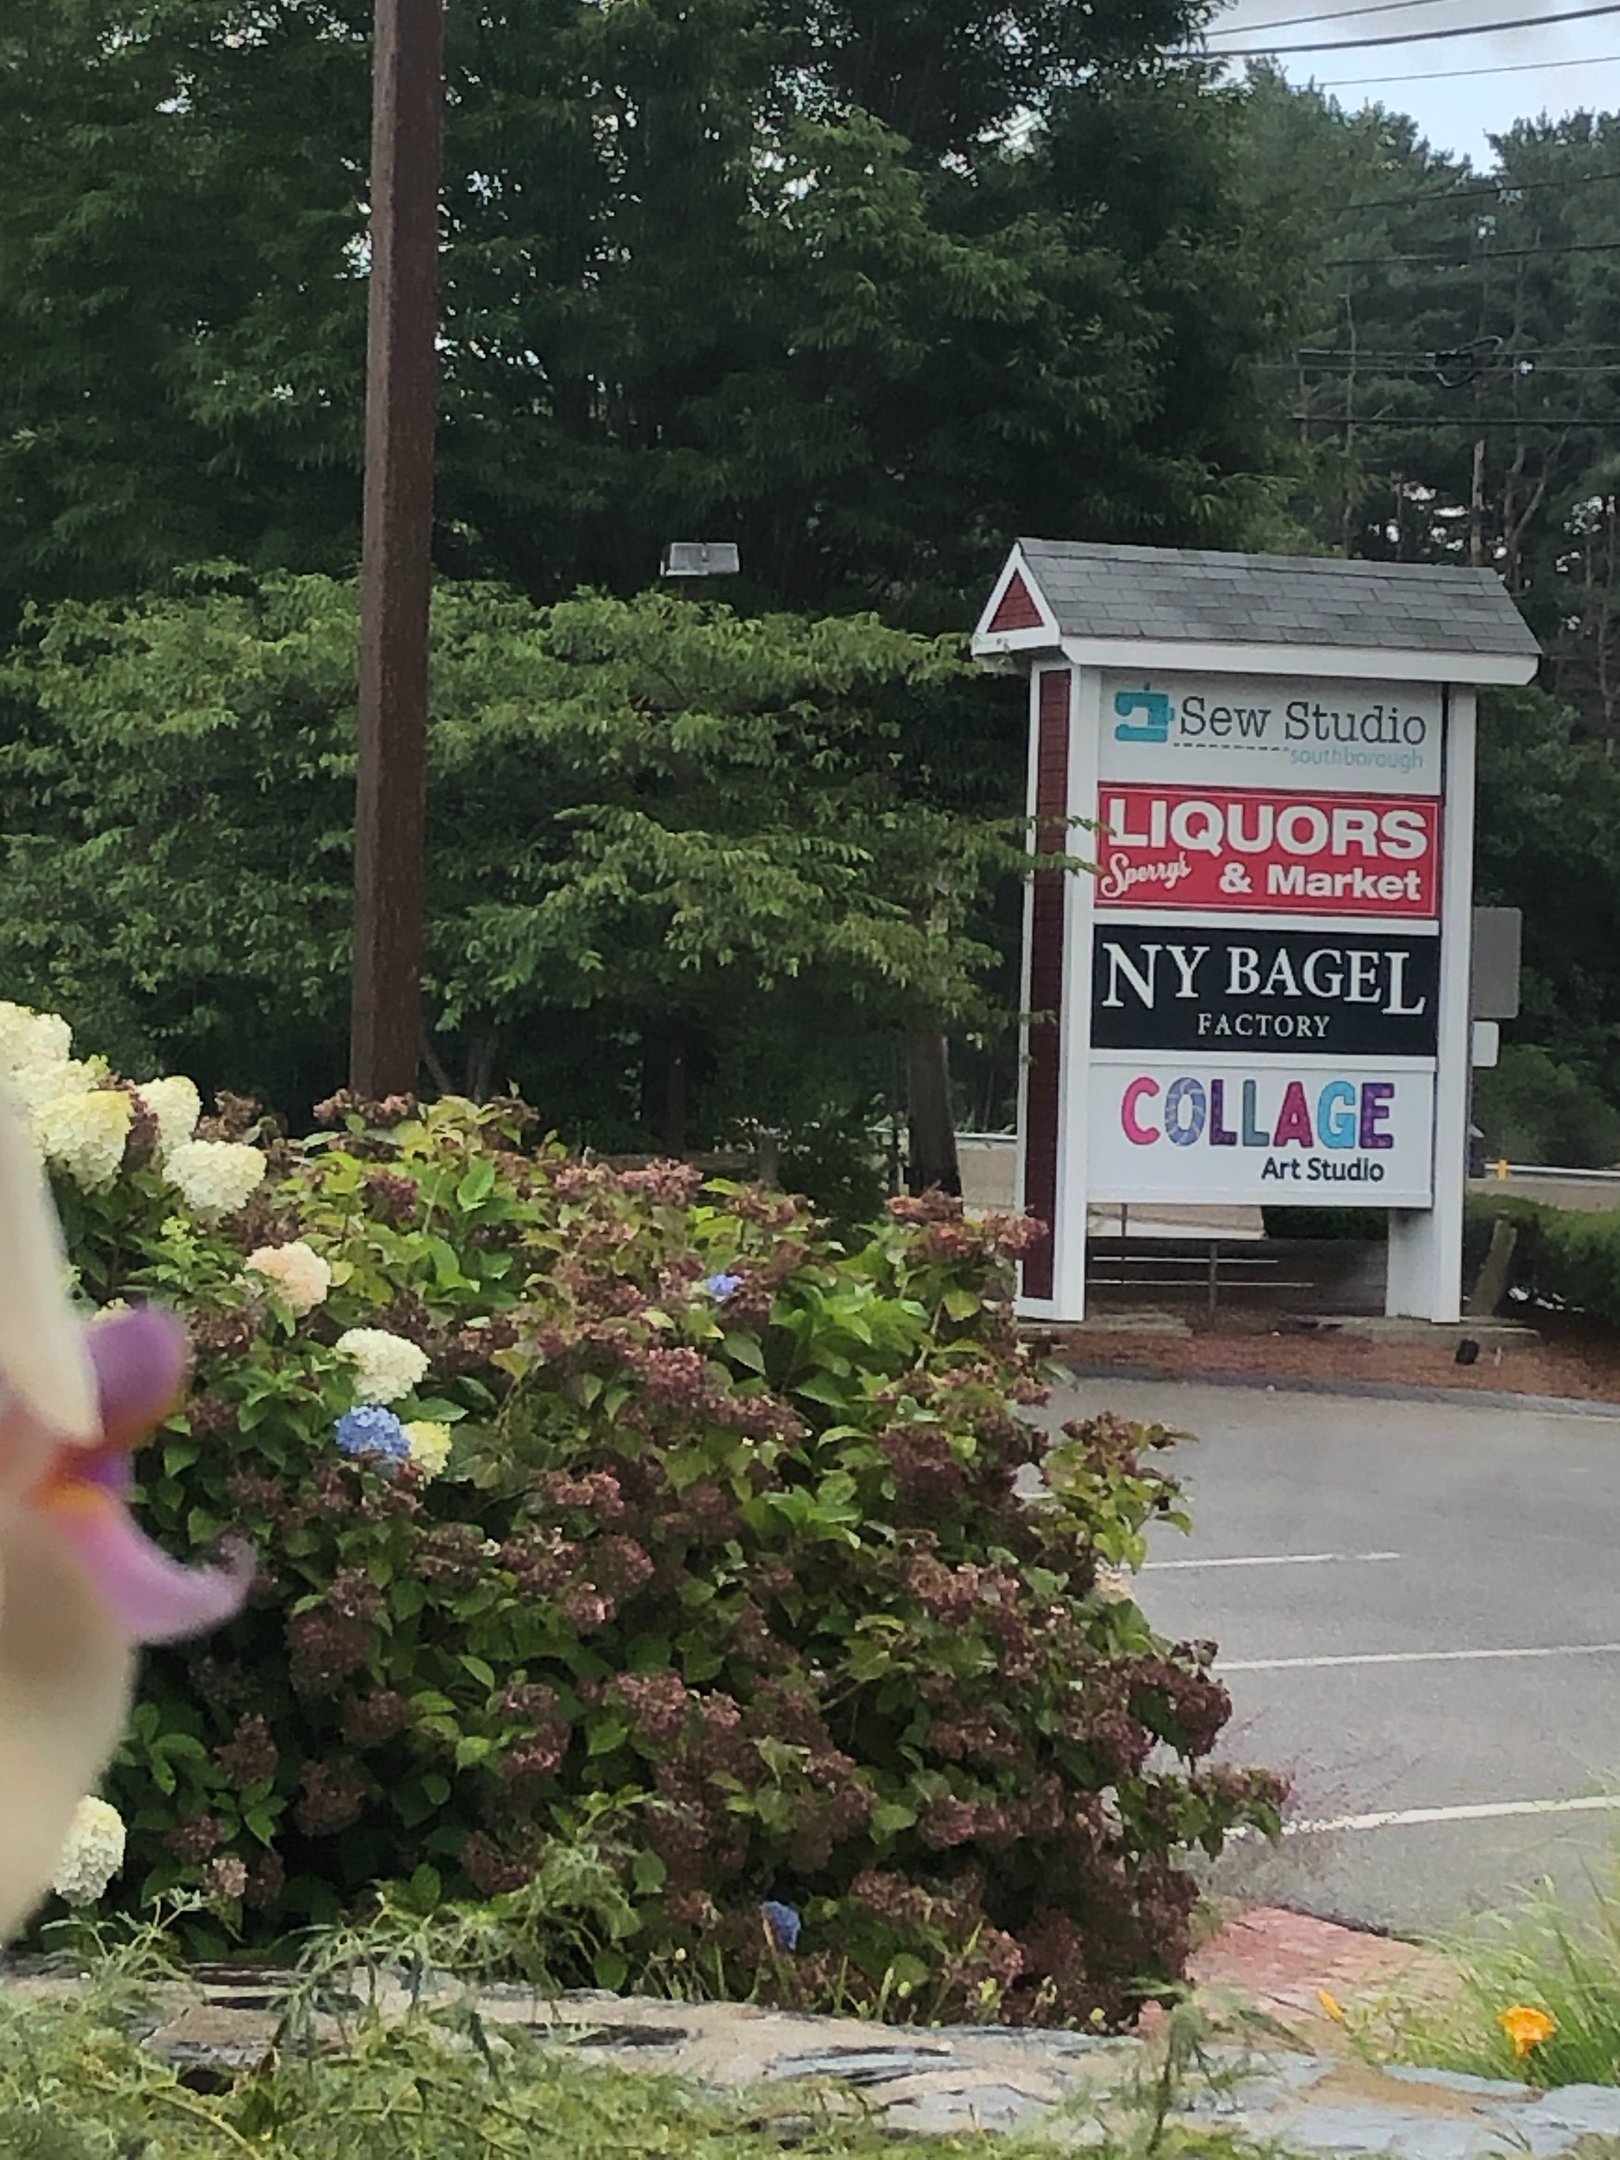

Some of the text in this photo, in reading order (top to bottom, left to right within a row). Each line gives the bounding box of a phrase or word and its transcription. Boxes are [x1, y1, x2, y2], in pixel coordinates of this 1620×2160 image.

[1180, 696, 1426, 745] Sew Studio
[1108, 798, 1428, 860] LIQUORS
[1219, 862, 1421, 900] & Market
[1101, 943, 1427, 1016] NY BAGEL
[1198, 1013, 1331, 1038] FACTORY
[1121, 1076, 1395, 1149] COLLAGE
[1261, 1157, 1385, 1182] Art Studio
